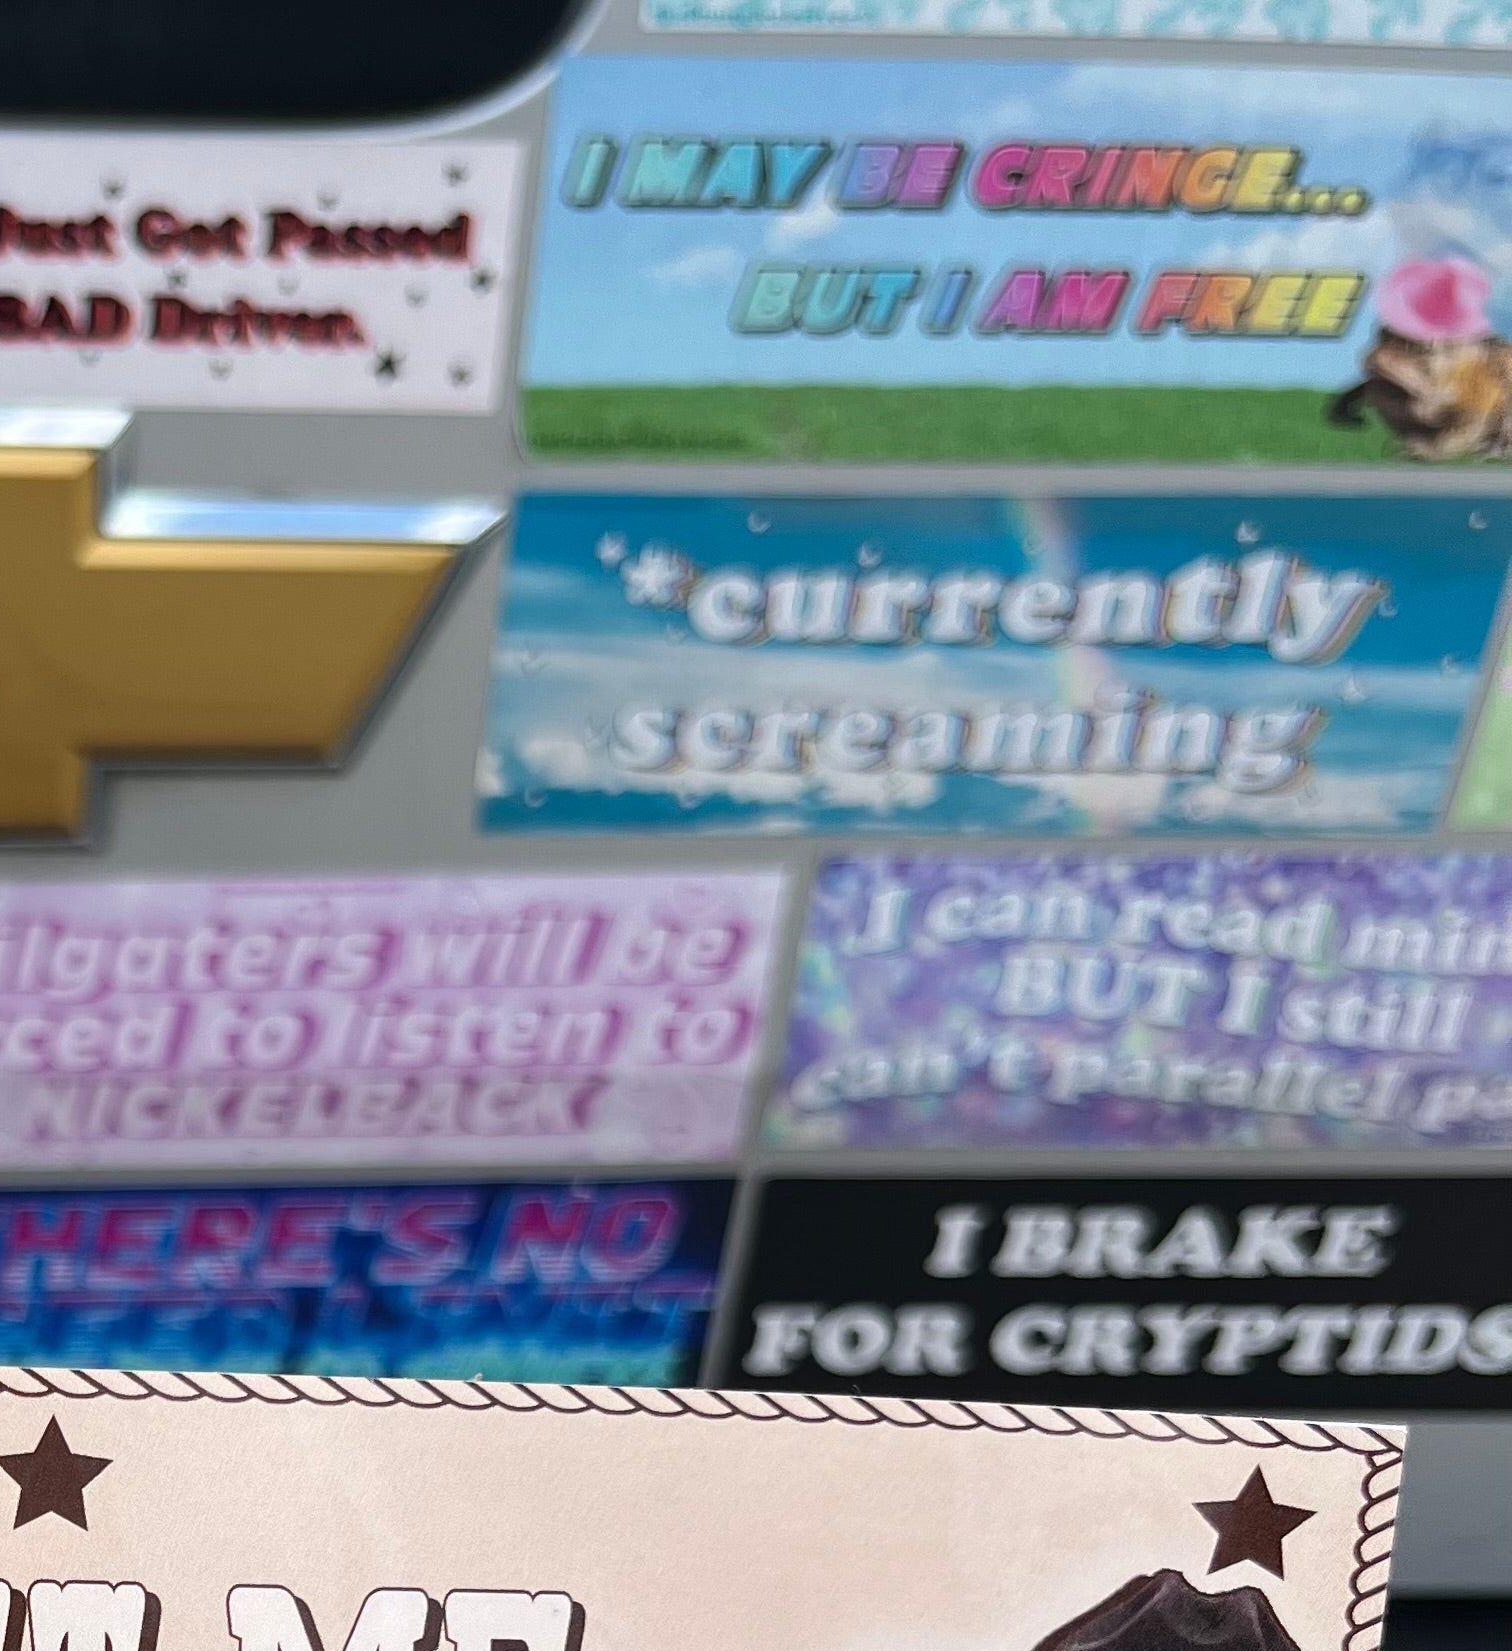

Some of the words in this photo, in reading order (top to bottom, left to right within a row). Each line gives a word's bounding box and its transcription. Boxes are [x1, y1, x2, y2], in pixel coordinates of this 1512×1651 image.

[566, 132, 617, 210] I
[618, 134, 834, 213] MAY
[834, 136, 968, 214] BE
[972, 140, 1374, 216] CRINGE...
[131, 205, 251, 264] Got
[262, 206, 475, 265] Passed
[729, 264, 924, 337] BUT
[921, 267, 976, 336] I
[976, 266, 1132, 338] AM
[1134, 266, 1370, 340] FREE
[610, 687, 1328, 795] screaming
[408, 904, 609, 991] will
[615, 914, 749, 986] be
[844, 886, 912, 956] I
[921, 888, 1092, 942] can
[1112, 894, 1337, 967] read
[203, 1000, 320, 1075] to
[322, 993, 624, 1070] listen
[628, 996, 756, 1067] to
[996, 951, 1206, 1028] BUT
[1218, 963, 1272, 1036] I
[1278, 976, 1473, 1054] still
[28, 1077, 613, 1143] NICKELBACK
[793, 1025, 1048, 1112] can't
[1050, 1042, 1409, 1126] parallel
[486, 1188, 683, 1287] NO
[923, 1202, 988, 1280] I
[990, 1202, 1400, 1280] BRAKE
[742, 1302, 970, 1377] FOR
[989, 1302, 1512, 1377] CRYPTIDS
